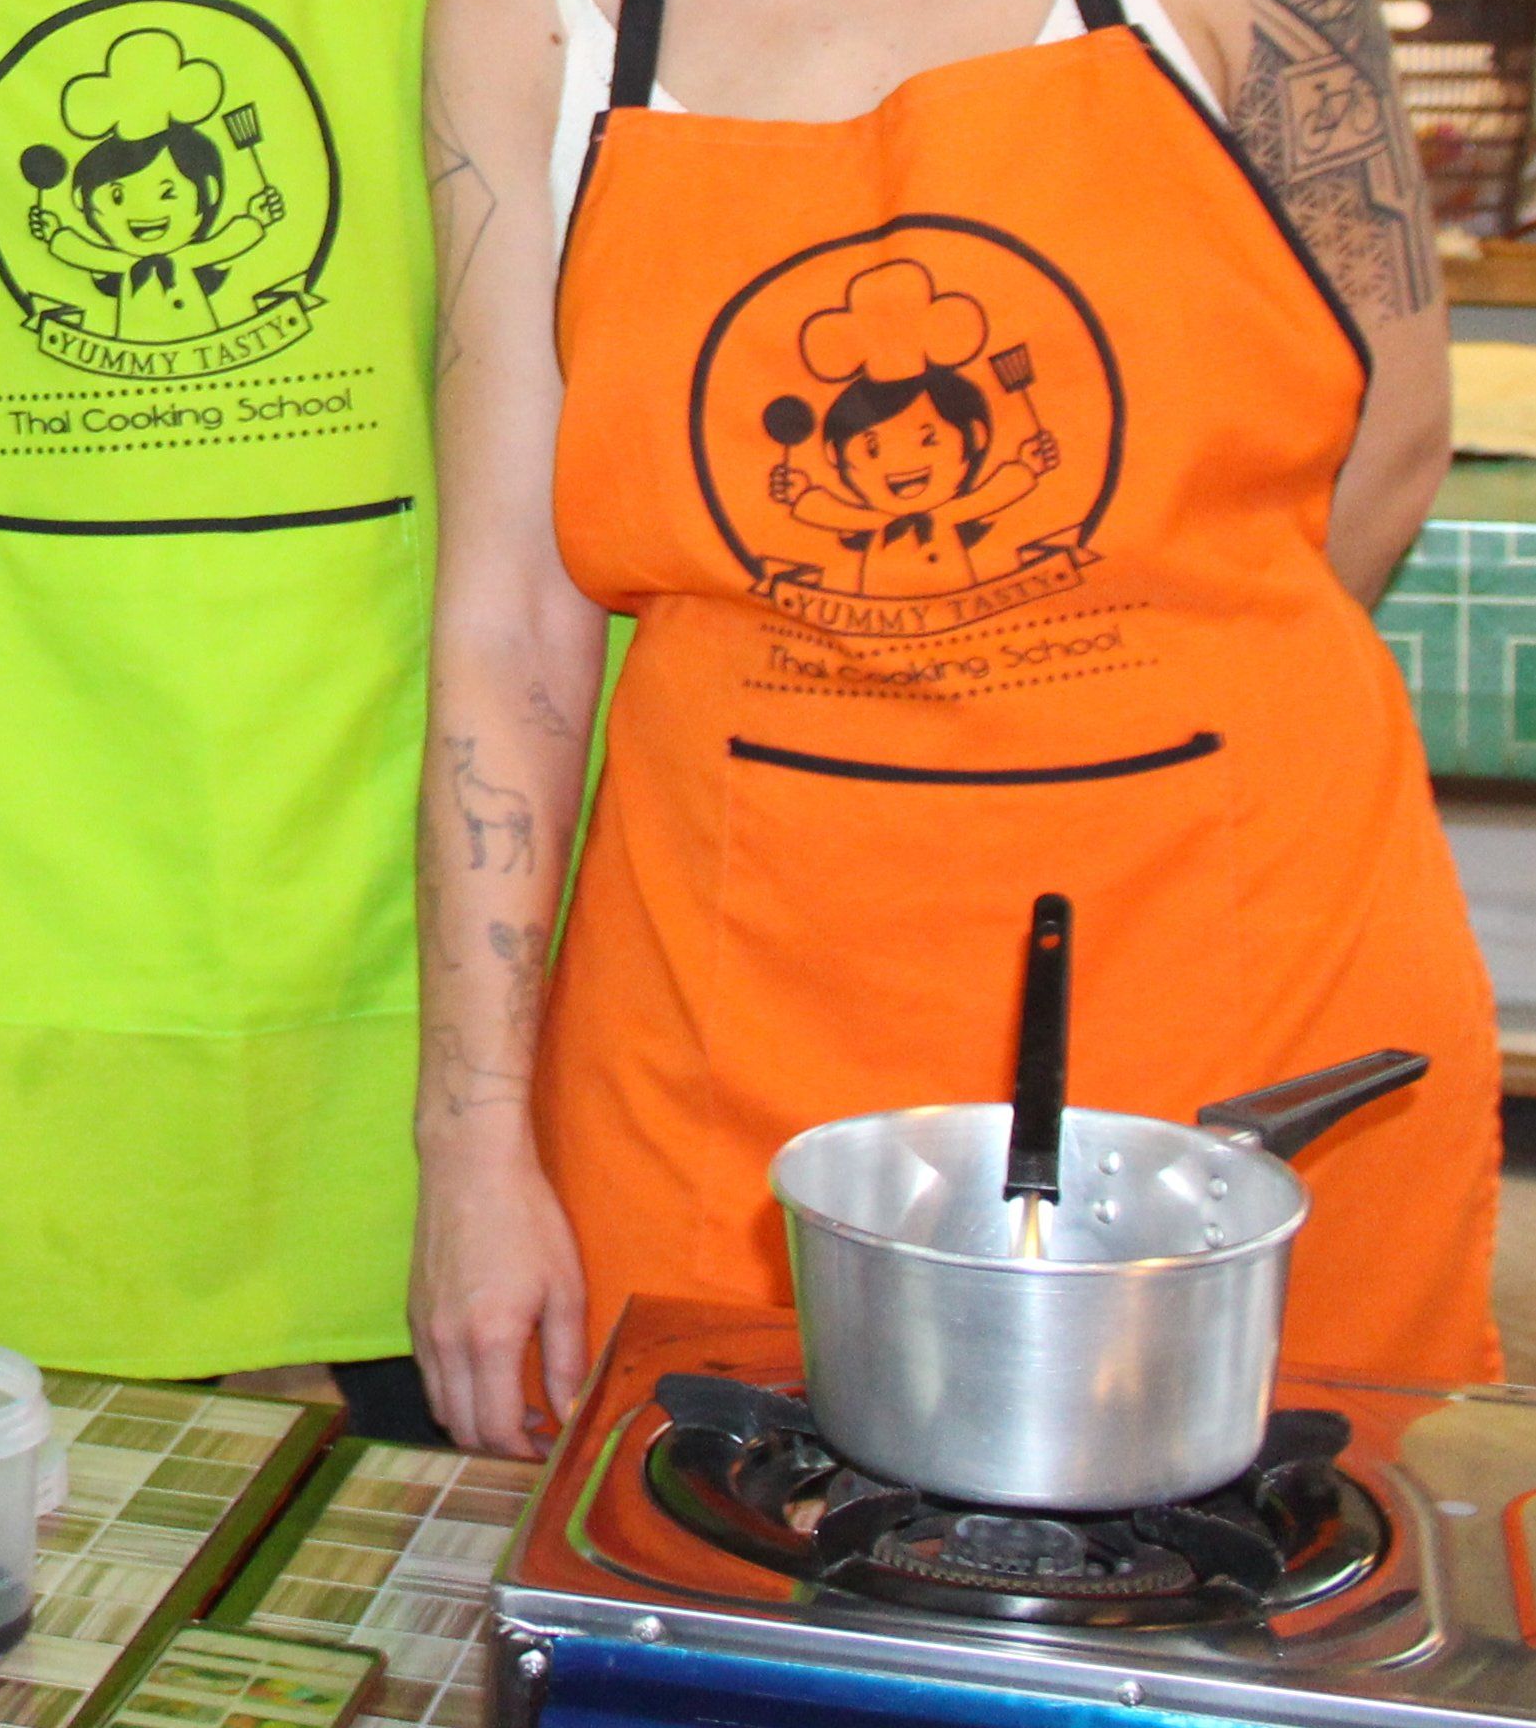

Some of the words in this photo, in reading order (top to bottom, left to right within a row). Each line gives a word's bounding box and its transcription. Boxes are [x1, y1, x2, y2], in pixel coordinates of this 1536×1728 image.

[59, 331, 180, 375] YUMMY
[193, 315, 288, 370] TASTY
[8, 410, 72, 435] Thai
[82, 403, 224, 431] Cooking
[237, 387, 354, 422] School
[797, 593, 930, 634] YUMMY
[947, 569, 1051, 622] TASTY
[769, 644, 829, 679] Thai
[1000, 623, 1124, 669] School
